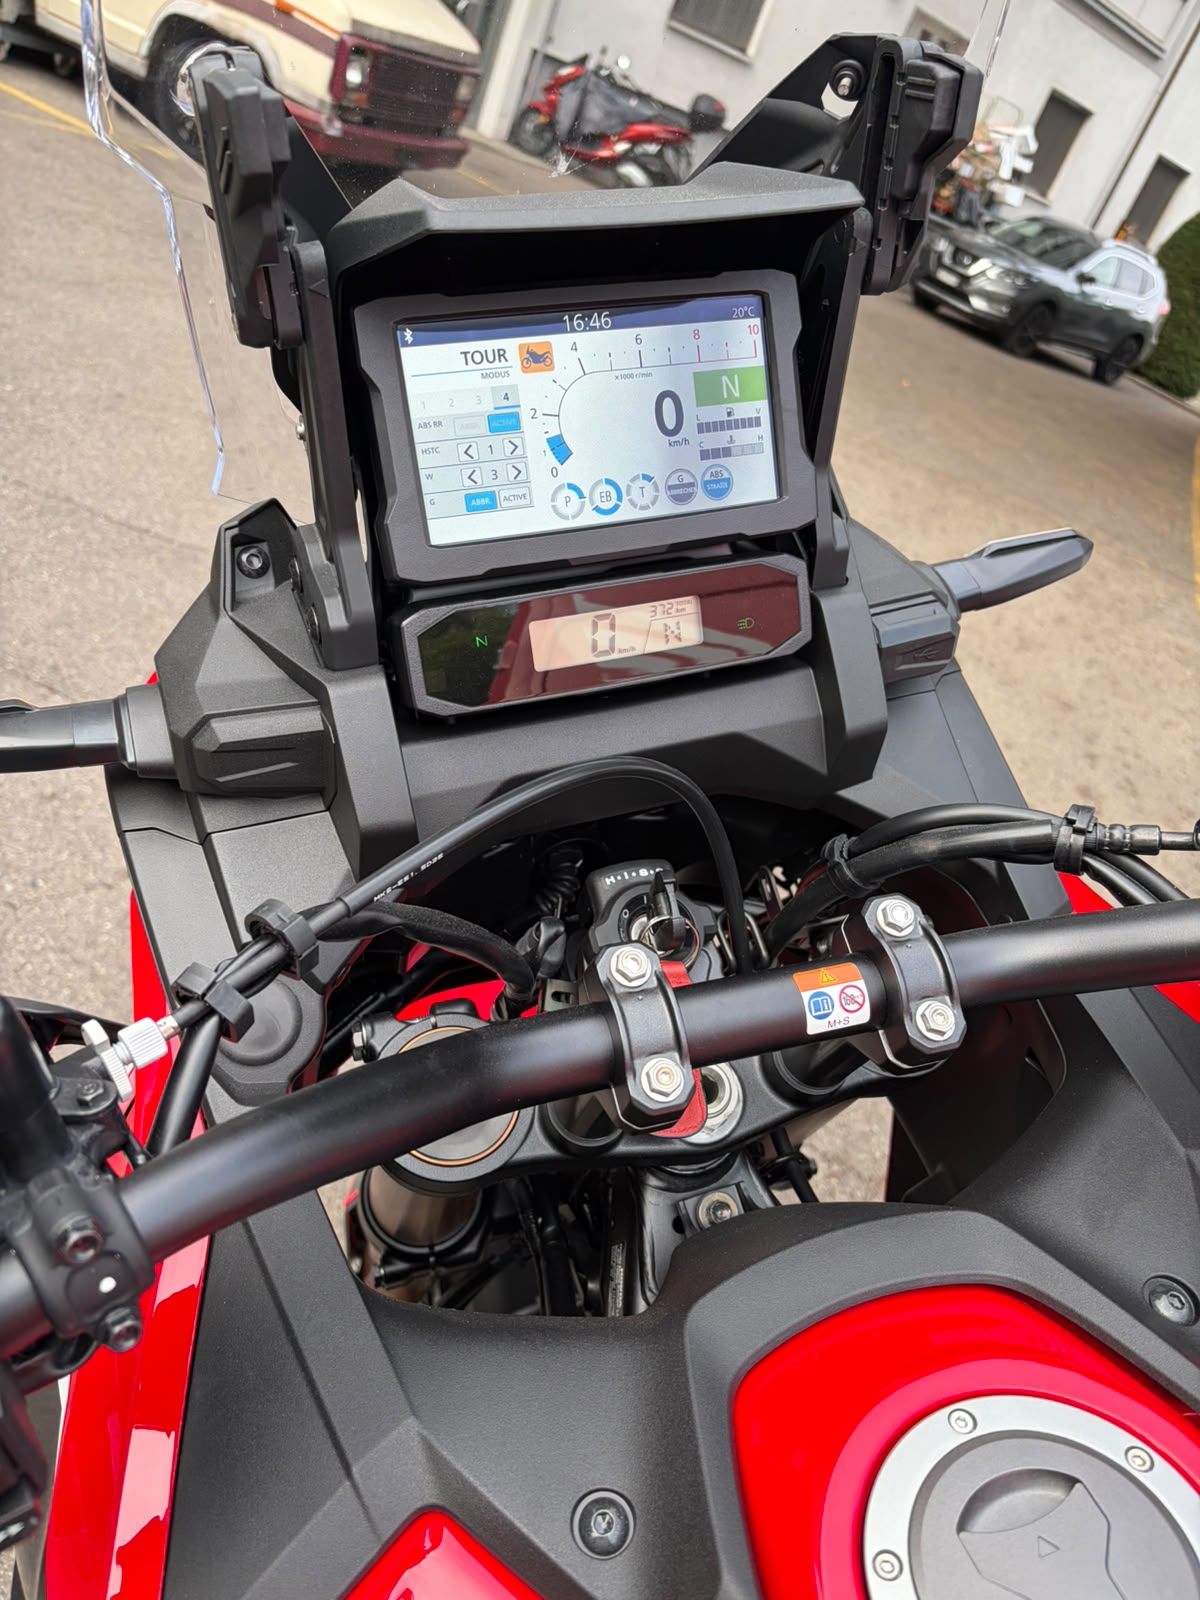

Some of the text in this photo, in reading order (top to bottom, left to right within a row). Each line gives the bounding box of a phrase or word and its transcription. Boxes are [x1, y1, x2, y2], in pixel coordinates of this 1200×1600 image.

[732, 306, 755, 318] 20°C
[563, 311, 612, 332] 16:46
[693, 328, 700, 341] 8
[747, 324, 759, 335] 10
[635, 333, 643, 345] 6
[570, 341, 578, 352] 4
[460, 348, 508, 366] TOUR
[481, 370, 510, 380] MODUS
[721, 374, 740, 399] N
[503, 392, 509, 401] 4
[530, 408, 537, 420] 2
[655, 389, 684, 438] 0
[417, 422, 431, 430] ABS
[668, 437, 690, 448] km/h
[421, 446, 440, 456] HSTC
[488, 444, 493, 455] 1
[425, 473, 434, 481] W
[491, 469, 498, 480] 3
[550, 466, 559, 478] 0
[710, 470, 724, 479] ABS
[677, 474, 684, 483] G
[502, 493, 528, 502] ACTIVE
[600, 491, 612, 503] EB
[639, 486, 646, 498] T
[564, 495, 571, 507] P
[591, 612, 616, 658] 0
[475, 635, 488, 648] N
[827, 1016, 850, 1029] M+S
